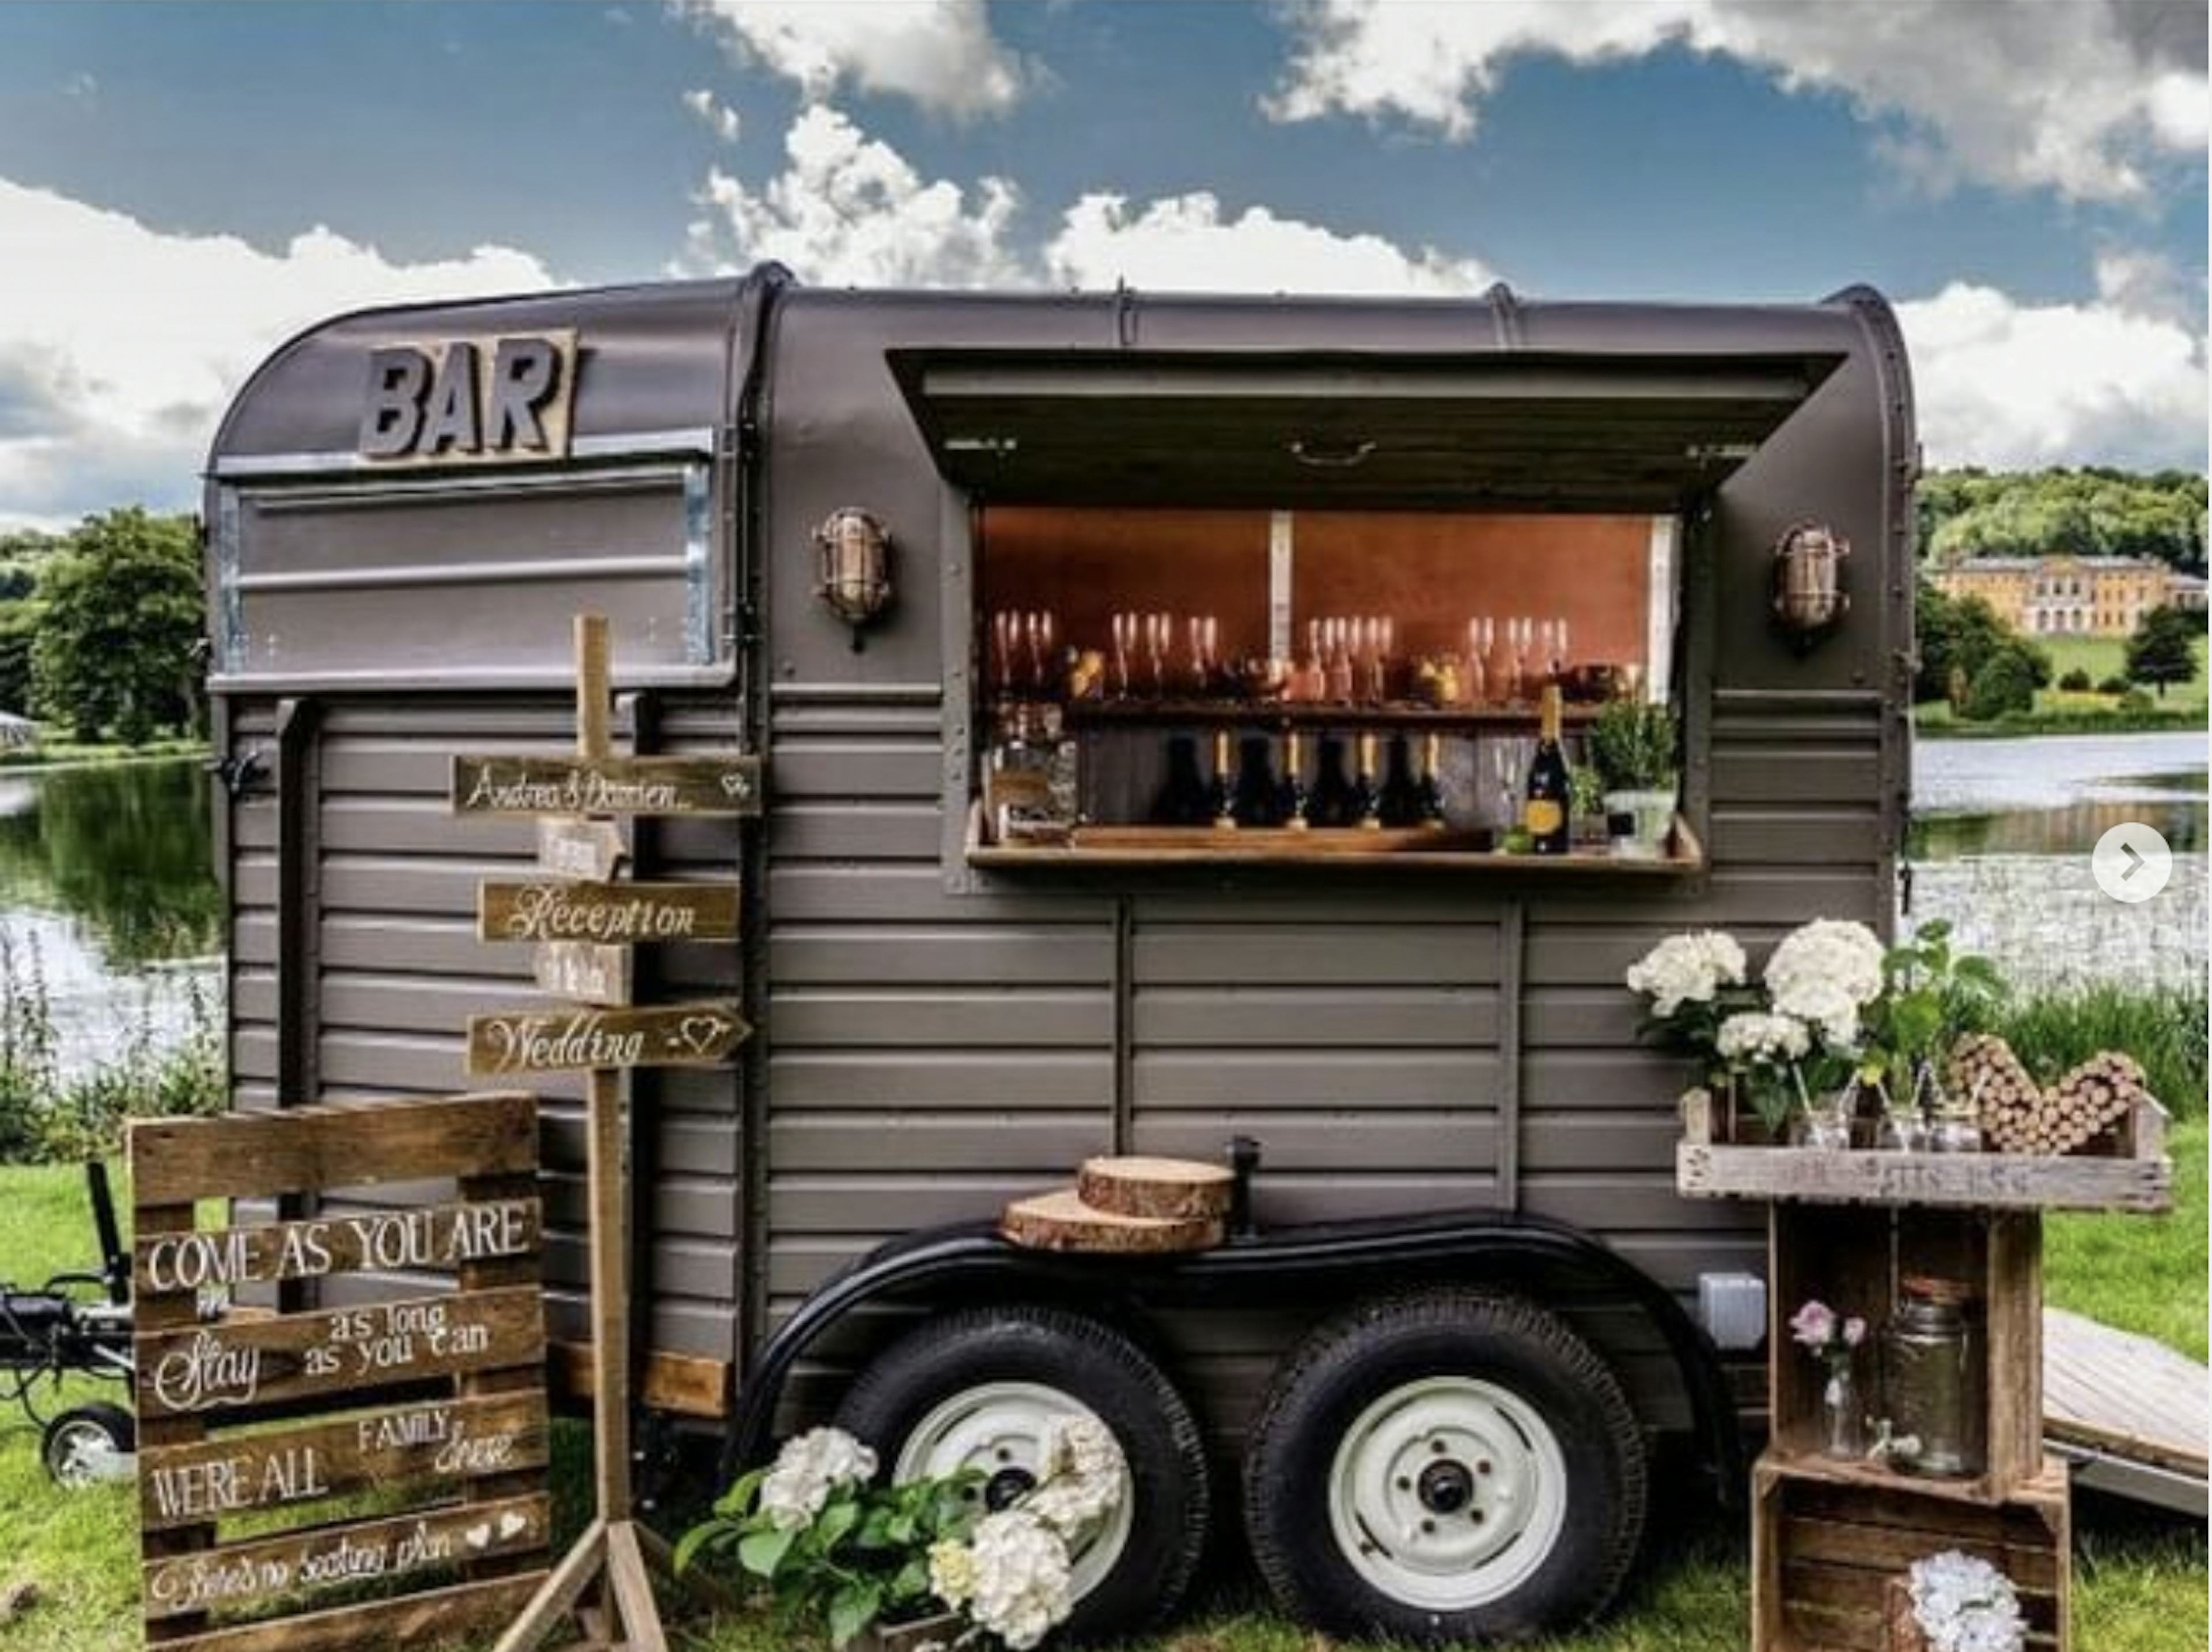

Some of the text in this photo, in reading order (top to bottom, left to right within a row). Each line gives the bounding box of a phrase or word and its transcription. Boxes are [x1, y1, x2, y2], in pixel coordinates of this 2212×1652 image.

[359, 339, 562, 460] BAR
[508, 882, 695, 940] Reception
[486, 1009, 645, 1070] Wedding
[149, 1203, 530, 1291] COME AS YOU ARE
[304, 1323, 490, 1376] as you can
[329, 1303, 447, 1343] as long
[153, 1328, 259, 1411] Stay
[358, 1408, 450, 1453] FAMILY
[259, 1446, 329, 1502] ALL
